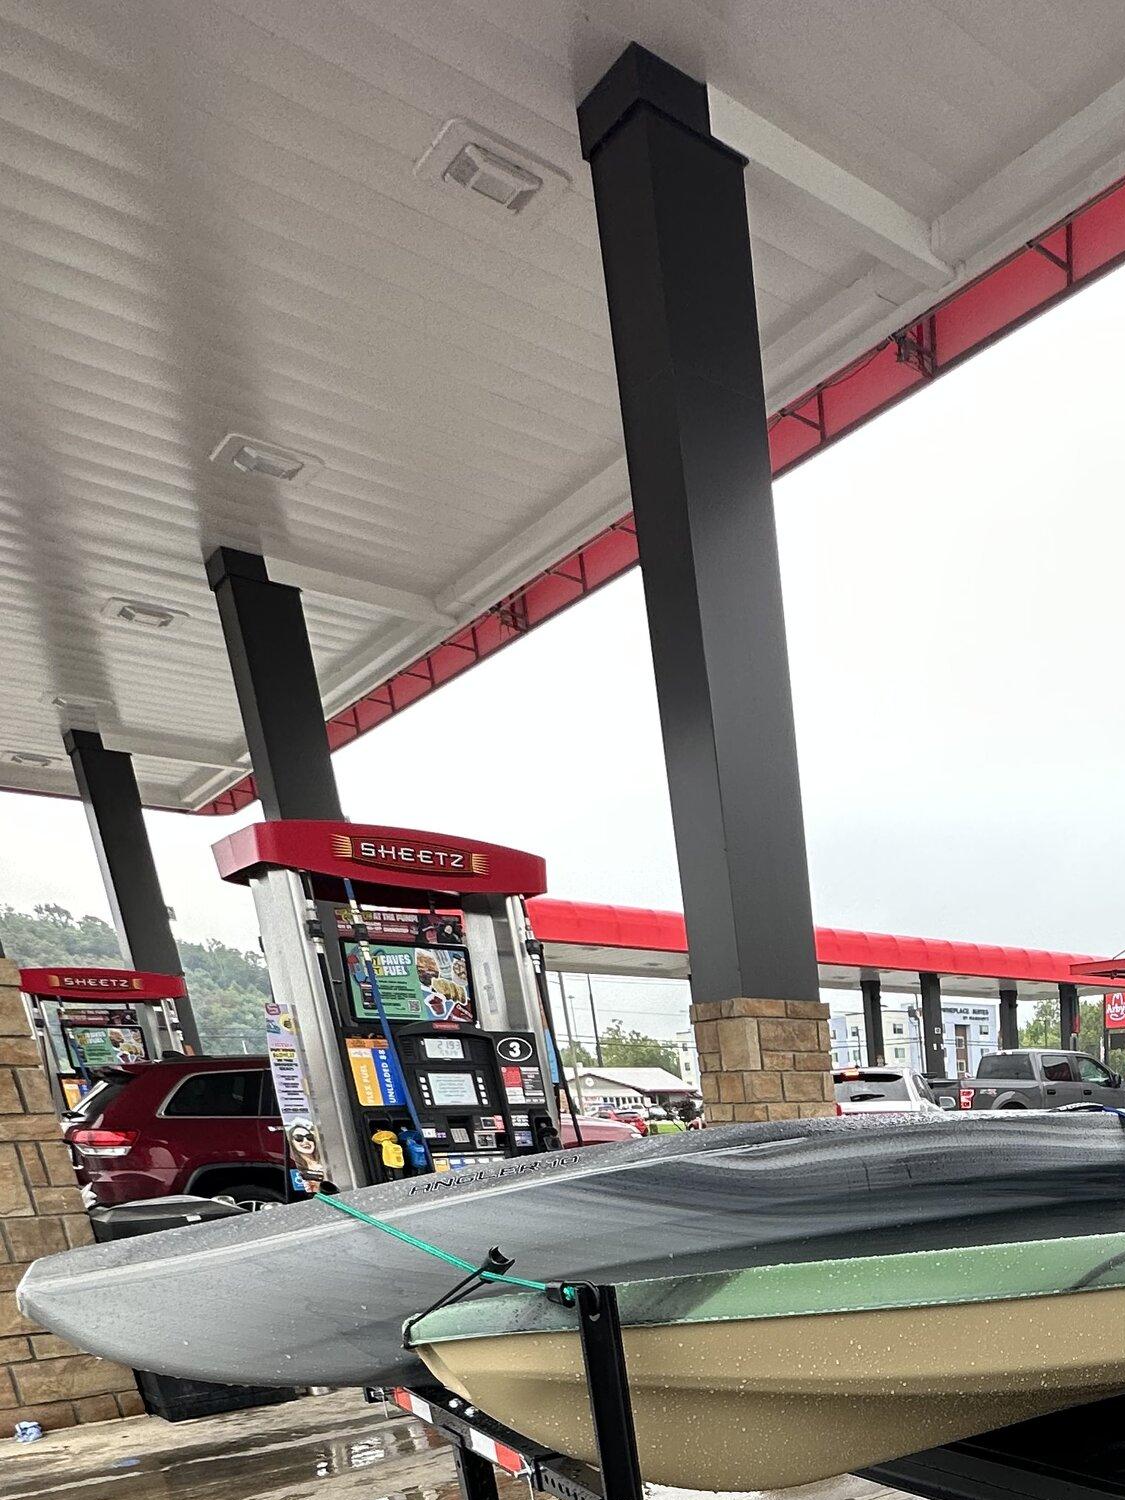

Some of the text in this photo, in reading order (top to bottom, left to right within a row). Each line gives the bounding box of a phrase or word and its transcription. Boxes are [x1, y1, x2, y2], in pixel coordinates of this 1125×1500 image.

[360, 842, 464, 868] SHEETZ
[381, 953, 412, 965] FAVES
[383, 965, 408, 976] FUEL
[64, 978, 129, 987] SHEETZ
[508, 1041, 521, 1058] 3
[383, 1063, 396, 1104] UNLEADED
[408, 1160, 540, 1197] ANGLER
